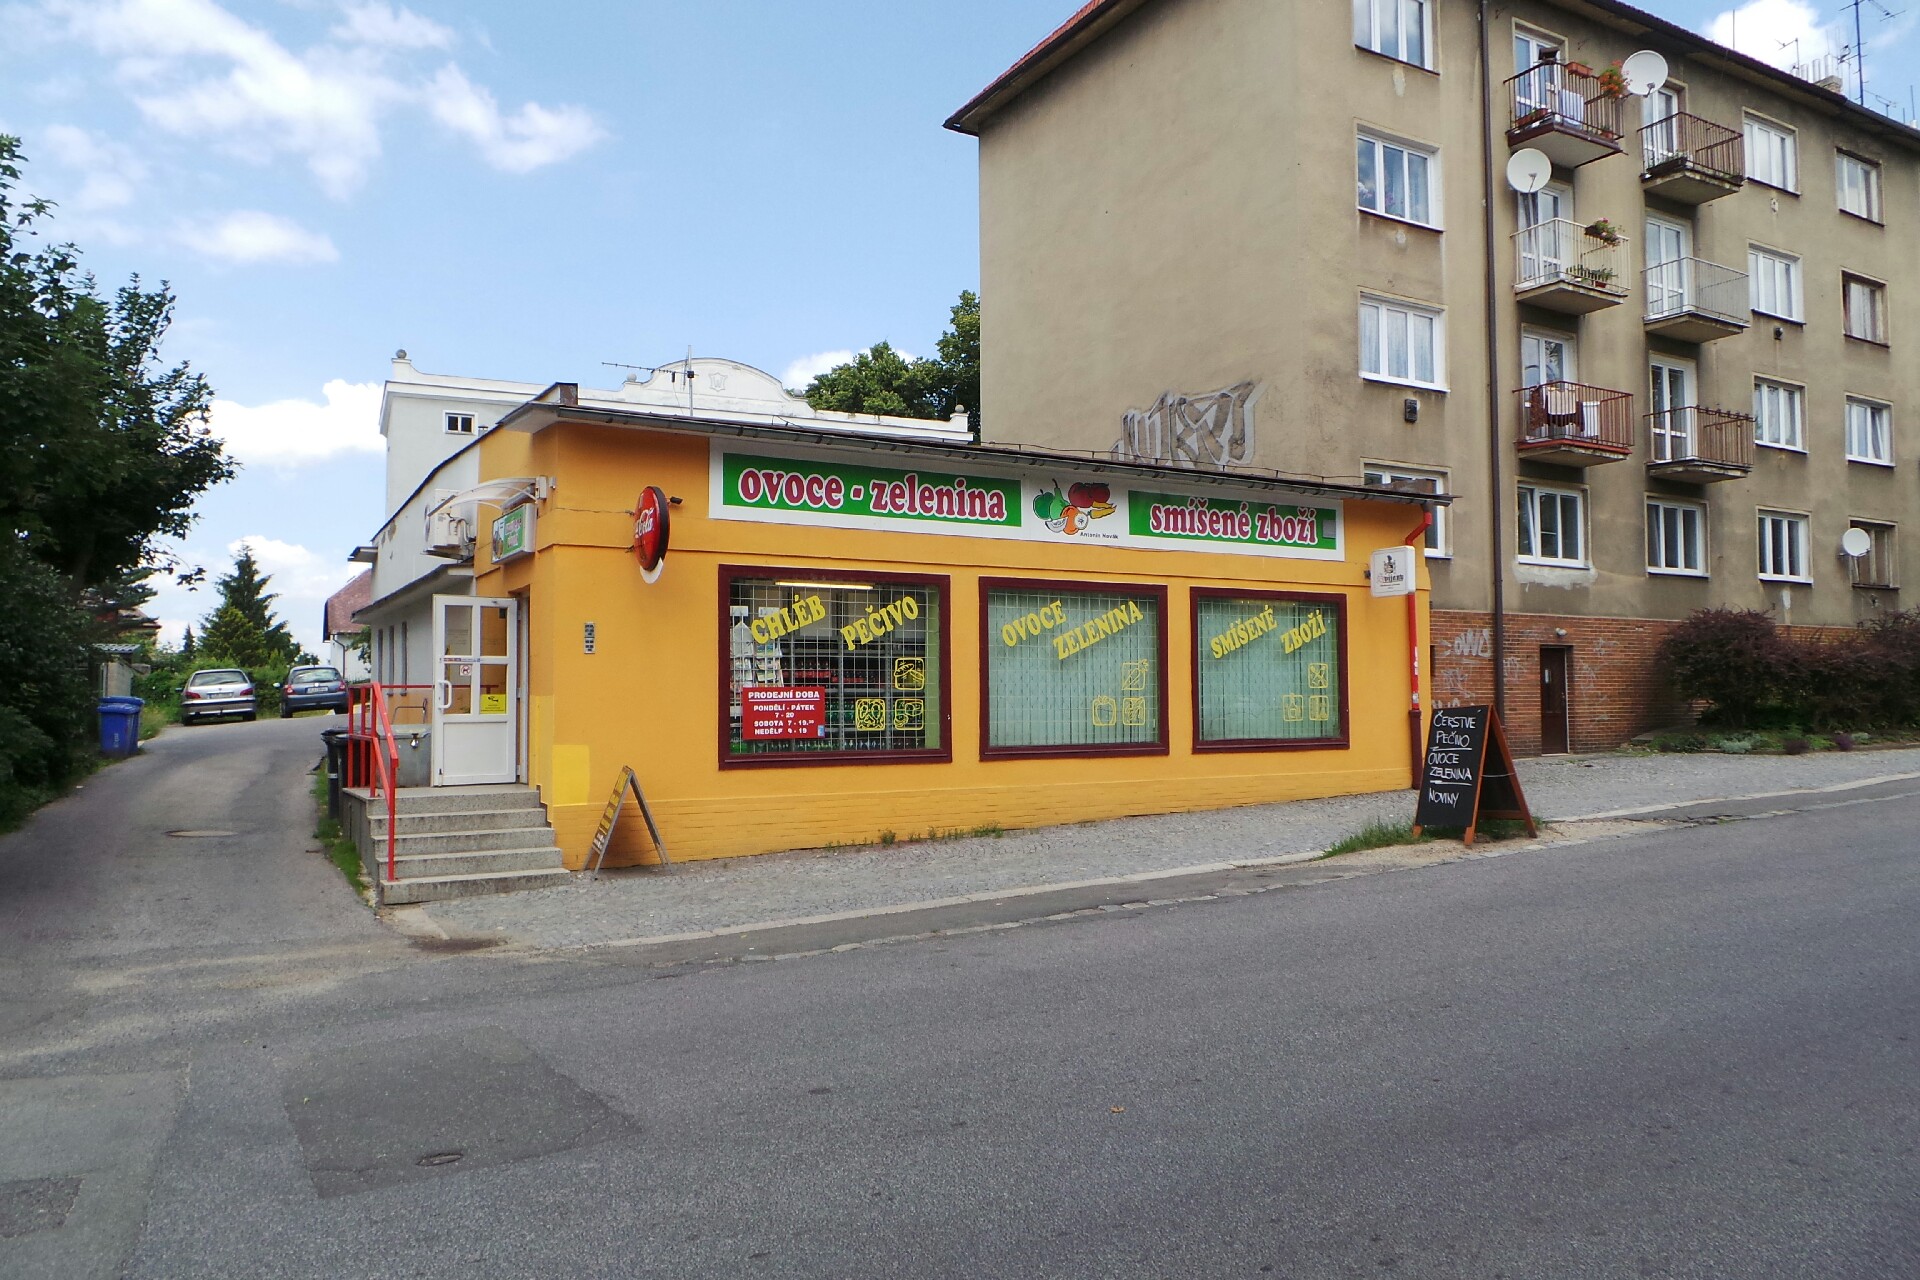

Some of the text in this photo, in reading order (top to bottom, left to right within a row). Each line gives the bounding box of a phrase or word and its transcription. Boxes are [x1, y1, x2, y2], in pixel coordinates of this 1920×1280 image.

[738, 468, 844, 508] ovoce
[869, 473, 1007, 521] zelenina
[1150, 497, 1318, 544] smíšené zboží
[751, 594, 919, 651] CHLÉB PEČIVO
[1002, 600, 1067, 648] OVOCE
[1053, 600, 1144, 660] ZELENINA
[1210, 605, 1326, 659] SMÍŠENÉ ZBOŽÍ
[748, 690, 793, 699] PRODEJNÍ
[753, 703, 785, 712] PONDĚLÍ
[791, 703, 815, 711] PÁTEK
[1428, 752, 1460, 765] OVOCE
[1429, 766, 1472, 781] ZELENINA
[1428, 787, 1460, 808] NOVINY
